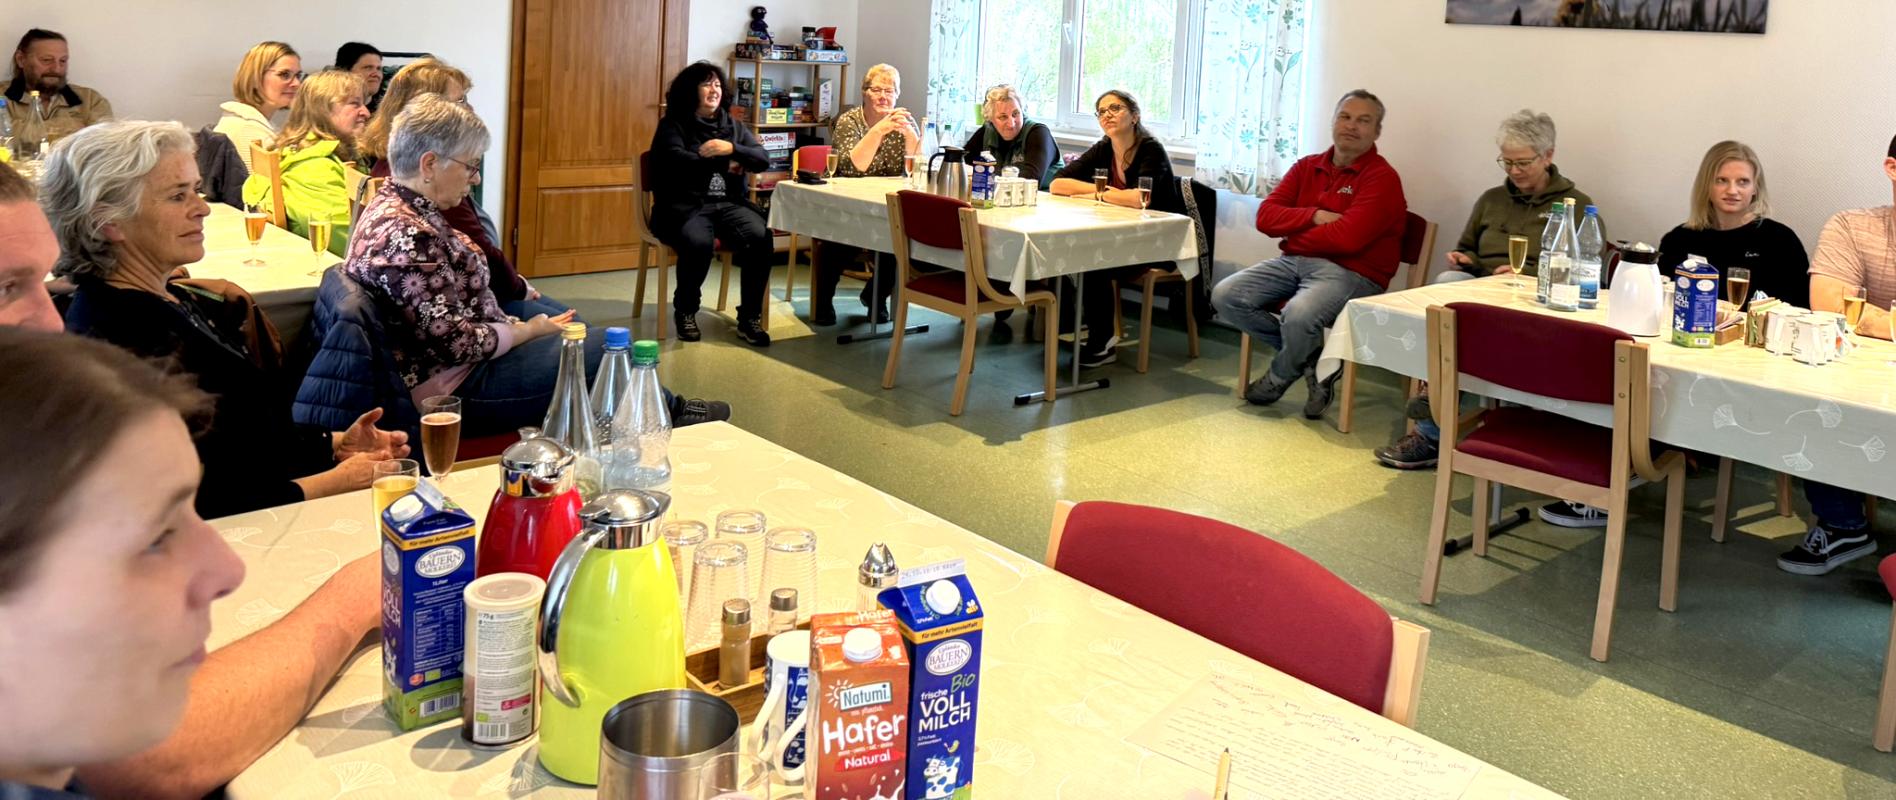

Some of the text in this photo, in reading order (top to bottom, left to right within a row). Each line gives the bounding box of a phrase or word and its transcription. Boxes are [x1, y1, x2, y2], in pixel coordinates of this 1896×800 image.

[420, 553, 461, 569] BAUERN
[857, 609, 895, 622] Hafer
[929, 648, 968, 666] BAUERN
[951, 673, 976, 693] Bio
[843, 683, 887, 707] Natumi
[920, 689, 948, 700] frische
[920, 691, 971, 718] VOLL
[918, 706, 971, 733] MILCH
[823, 714, 906, 755] Hafer
[844, 748, 891, 769] Natural
